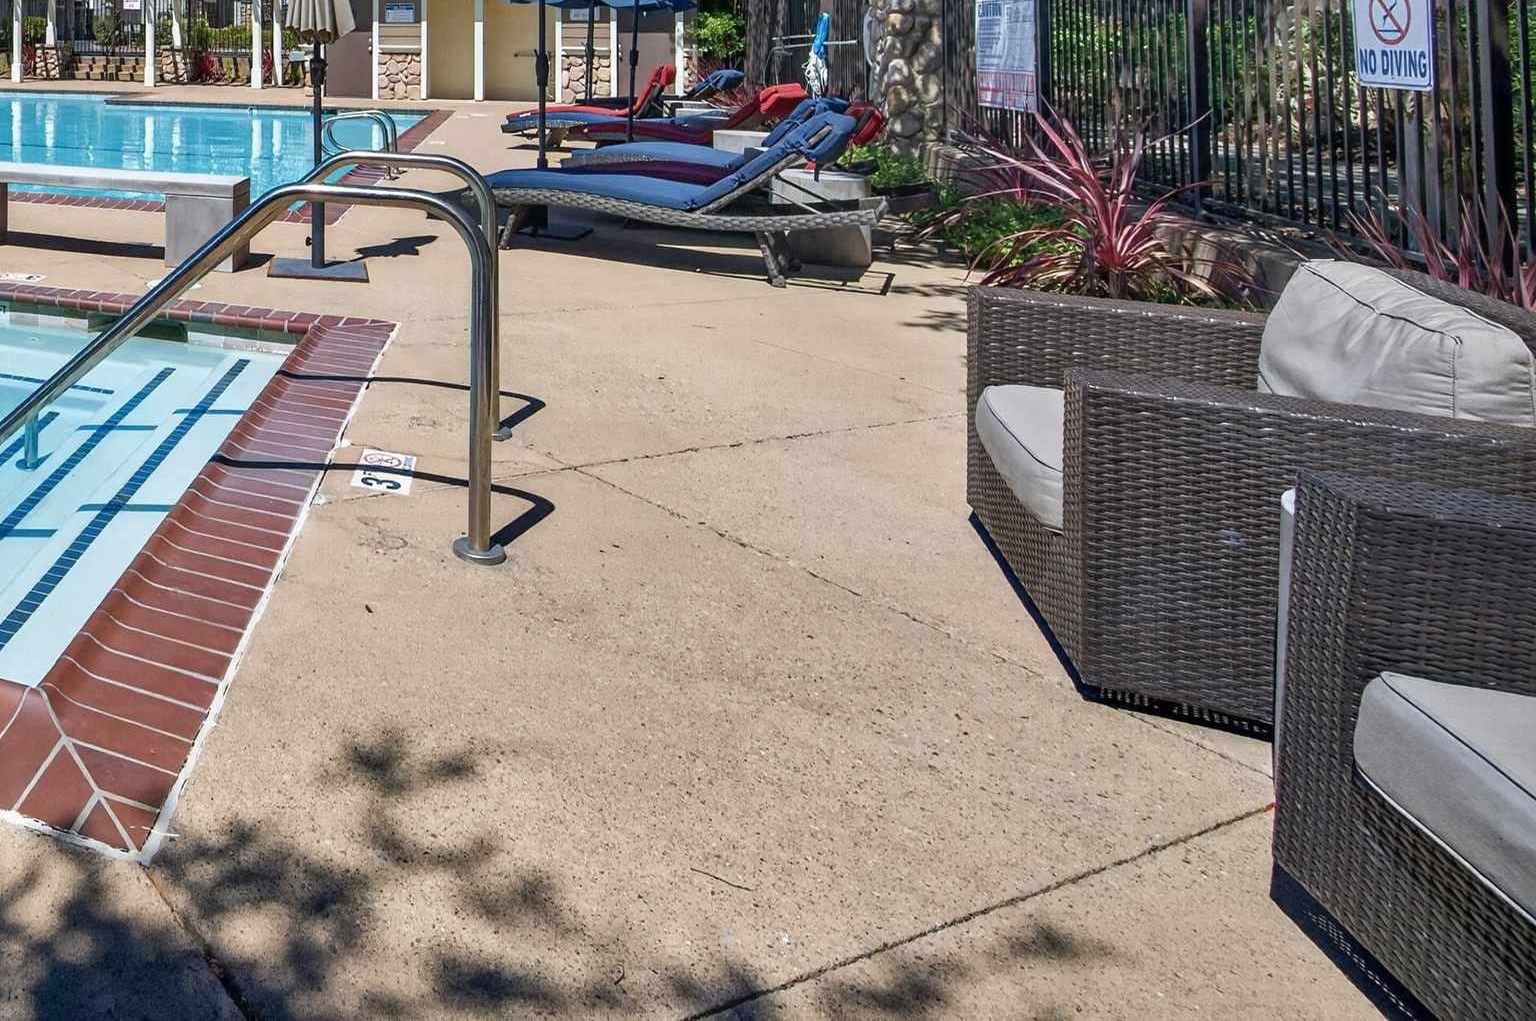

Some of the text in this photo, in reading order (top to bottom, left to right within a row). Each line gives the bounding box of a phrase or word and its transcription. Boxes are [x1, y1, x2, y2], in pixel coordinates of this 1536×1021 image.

[1359, 48, 1427, 78] NO DIVING
[361, 476, 402, 490] 3
